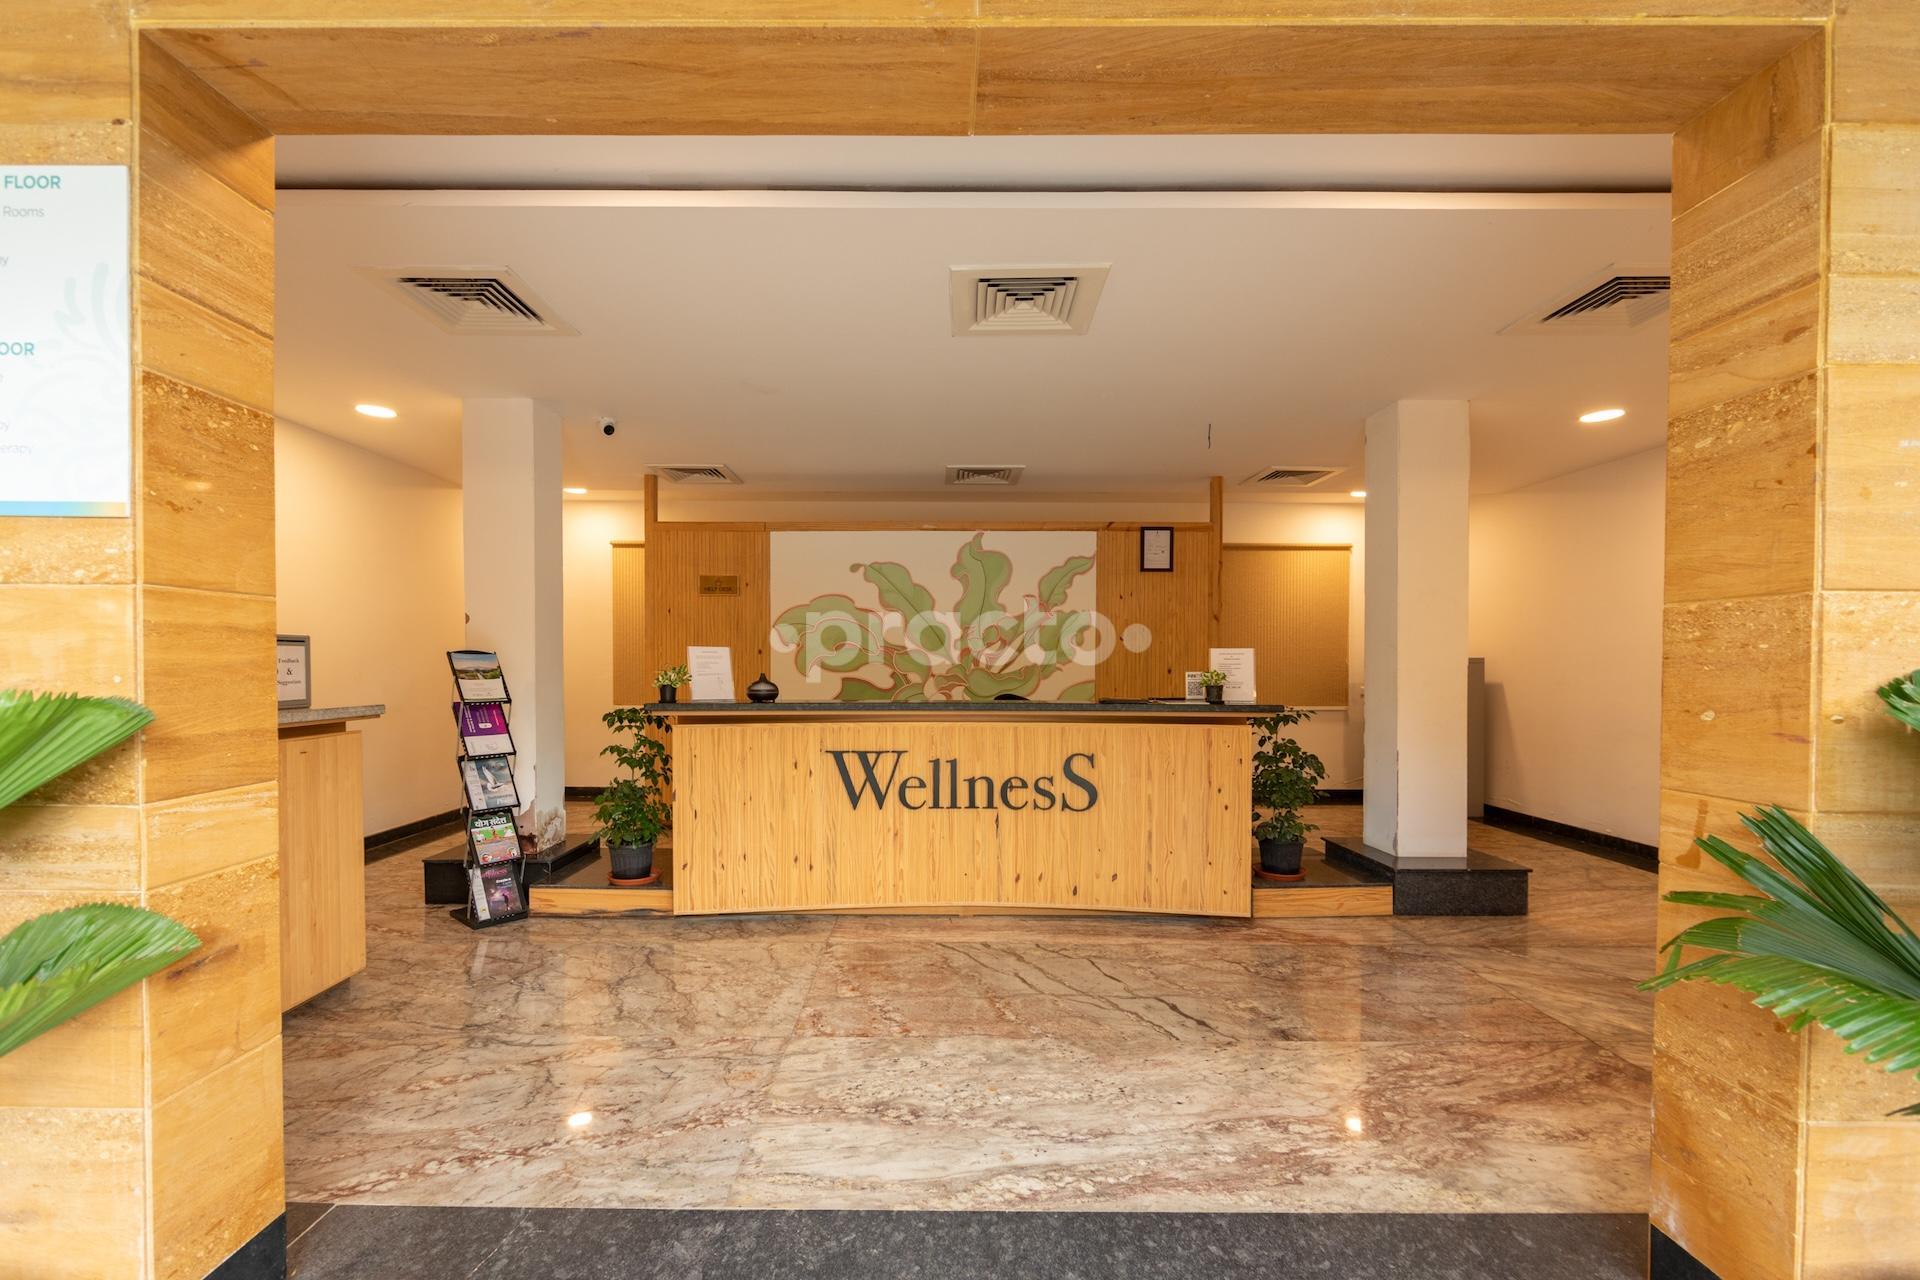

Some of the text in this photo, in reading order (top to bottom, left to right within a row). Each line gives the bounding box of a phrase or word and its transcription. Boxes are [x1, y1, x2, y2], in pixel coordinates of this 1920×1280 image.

[4, 175, 61, 189] FLOOR
[2, 205, 45, 217] Rooms
[286, 667, 293, 675] &
[825, 750, 1098, 812] WellnesS
